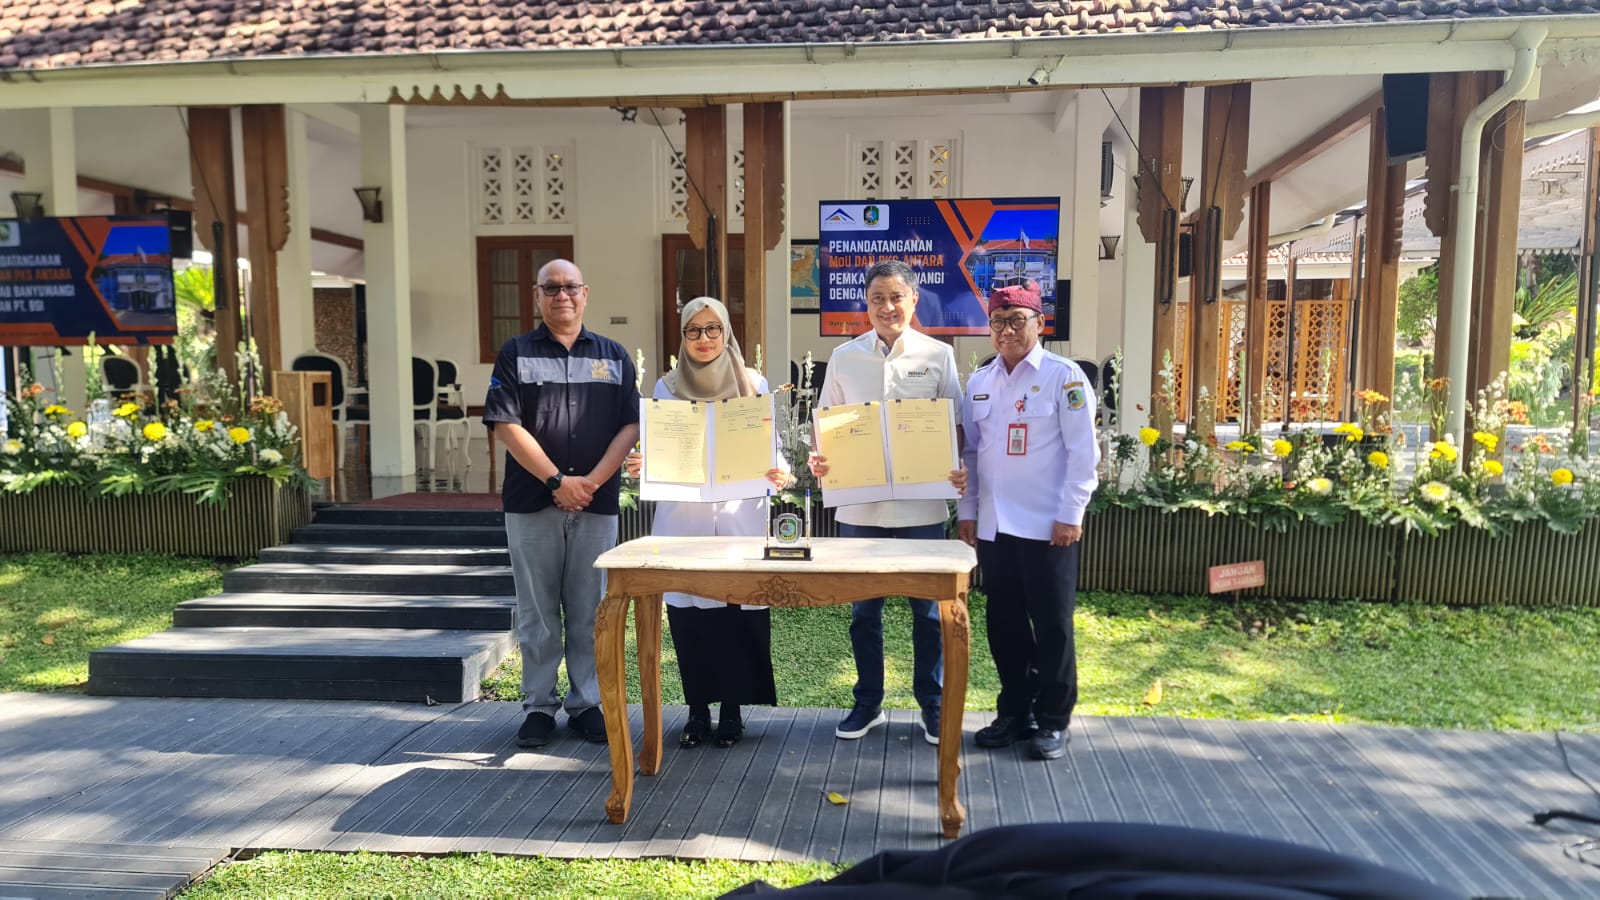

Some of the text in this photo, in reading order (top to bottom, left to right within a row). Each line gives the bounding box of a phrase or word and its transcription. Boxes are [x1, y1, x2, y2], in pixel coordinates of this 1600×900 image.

[829, 240, 933, 253] PENANDATANGANAN
[829, 255, 851, 267] MoU
[855, 255, 876, 268] DAN
[903, 254, 944, 267] ANTARA
[829, 272, 866, 285] PEMKA
[13, 285, 75, 297] BANYUWANGI
[1218, 565, 1256, 578] JANGAN
